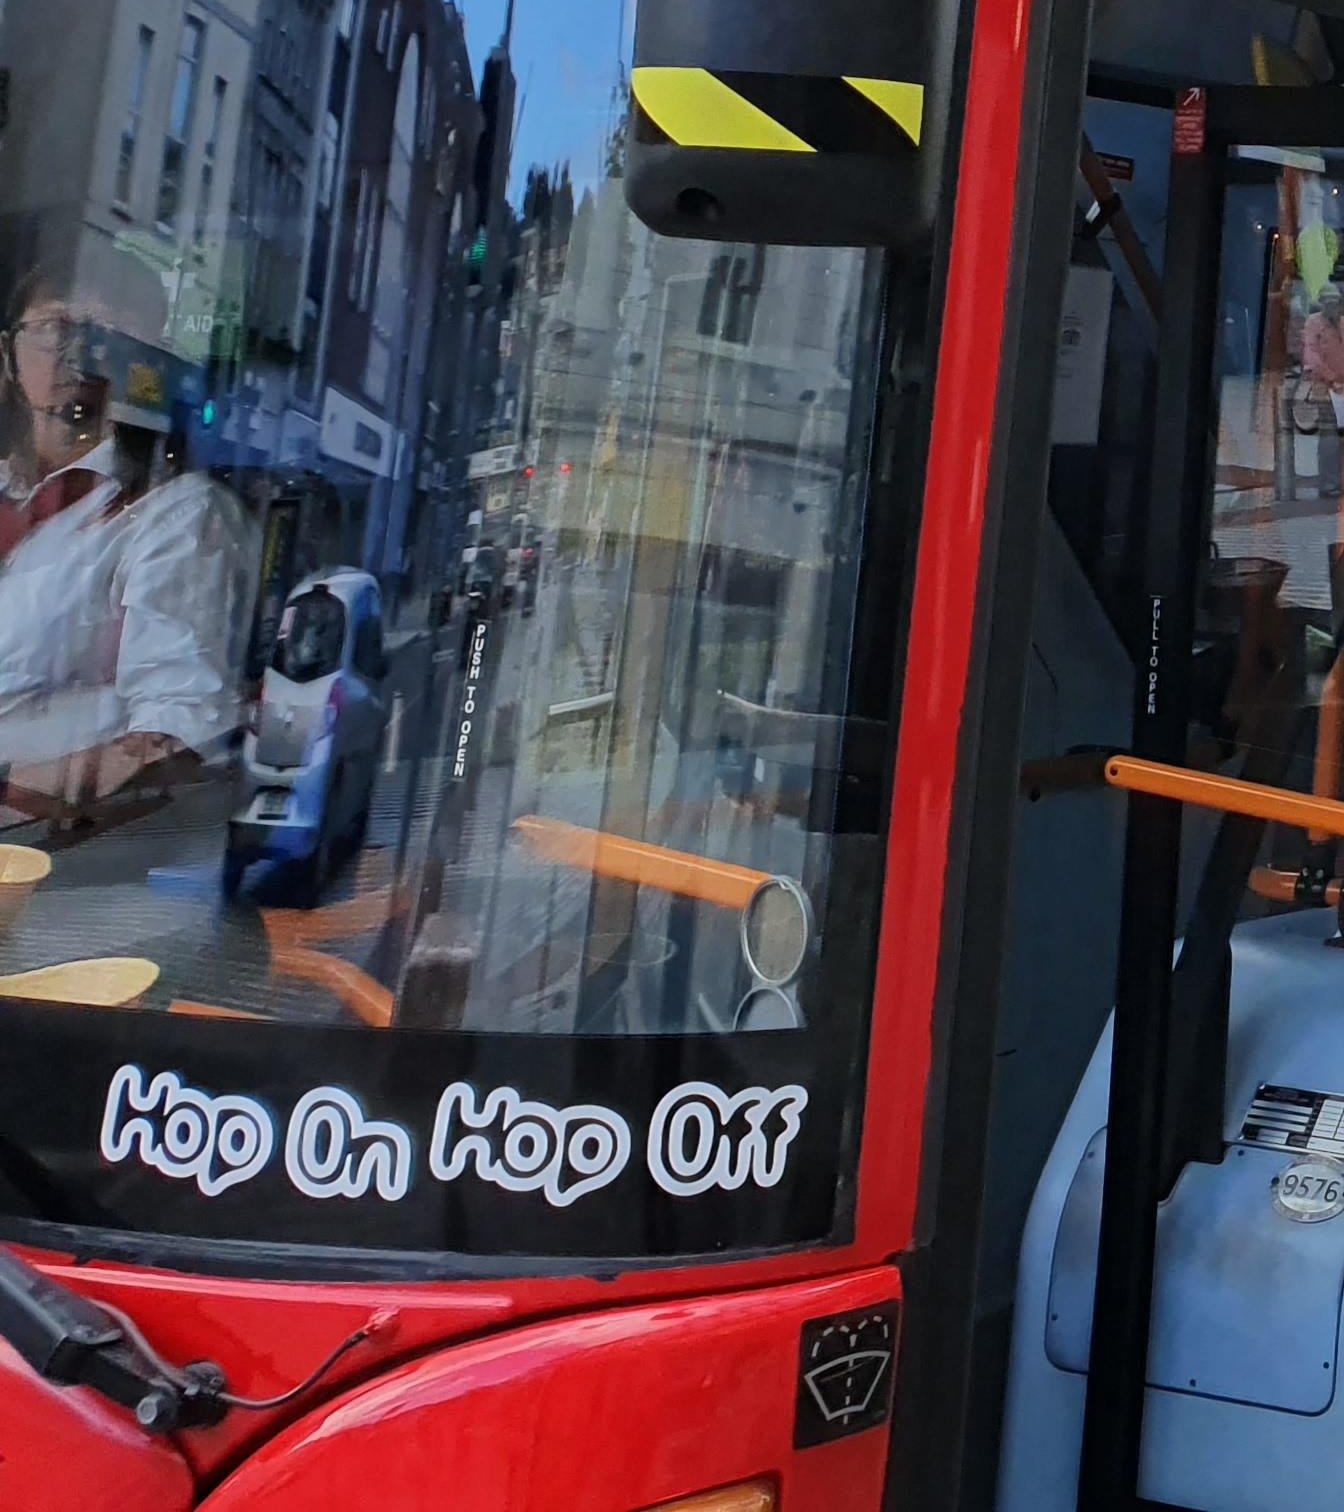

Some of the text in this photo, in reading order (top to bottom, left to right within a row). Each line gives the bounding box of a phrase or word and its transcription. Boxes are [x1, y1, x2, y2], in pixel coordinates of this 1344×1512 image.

[454, 624, 486, 776] PUSH TO OPEN
[1147, 599, 1161, 714] PULL TO OPEN
[100, 1064, 808, 1207] Hop On Hop Off
[1282, 1174, 1340, 1203] 9576
